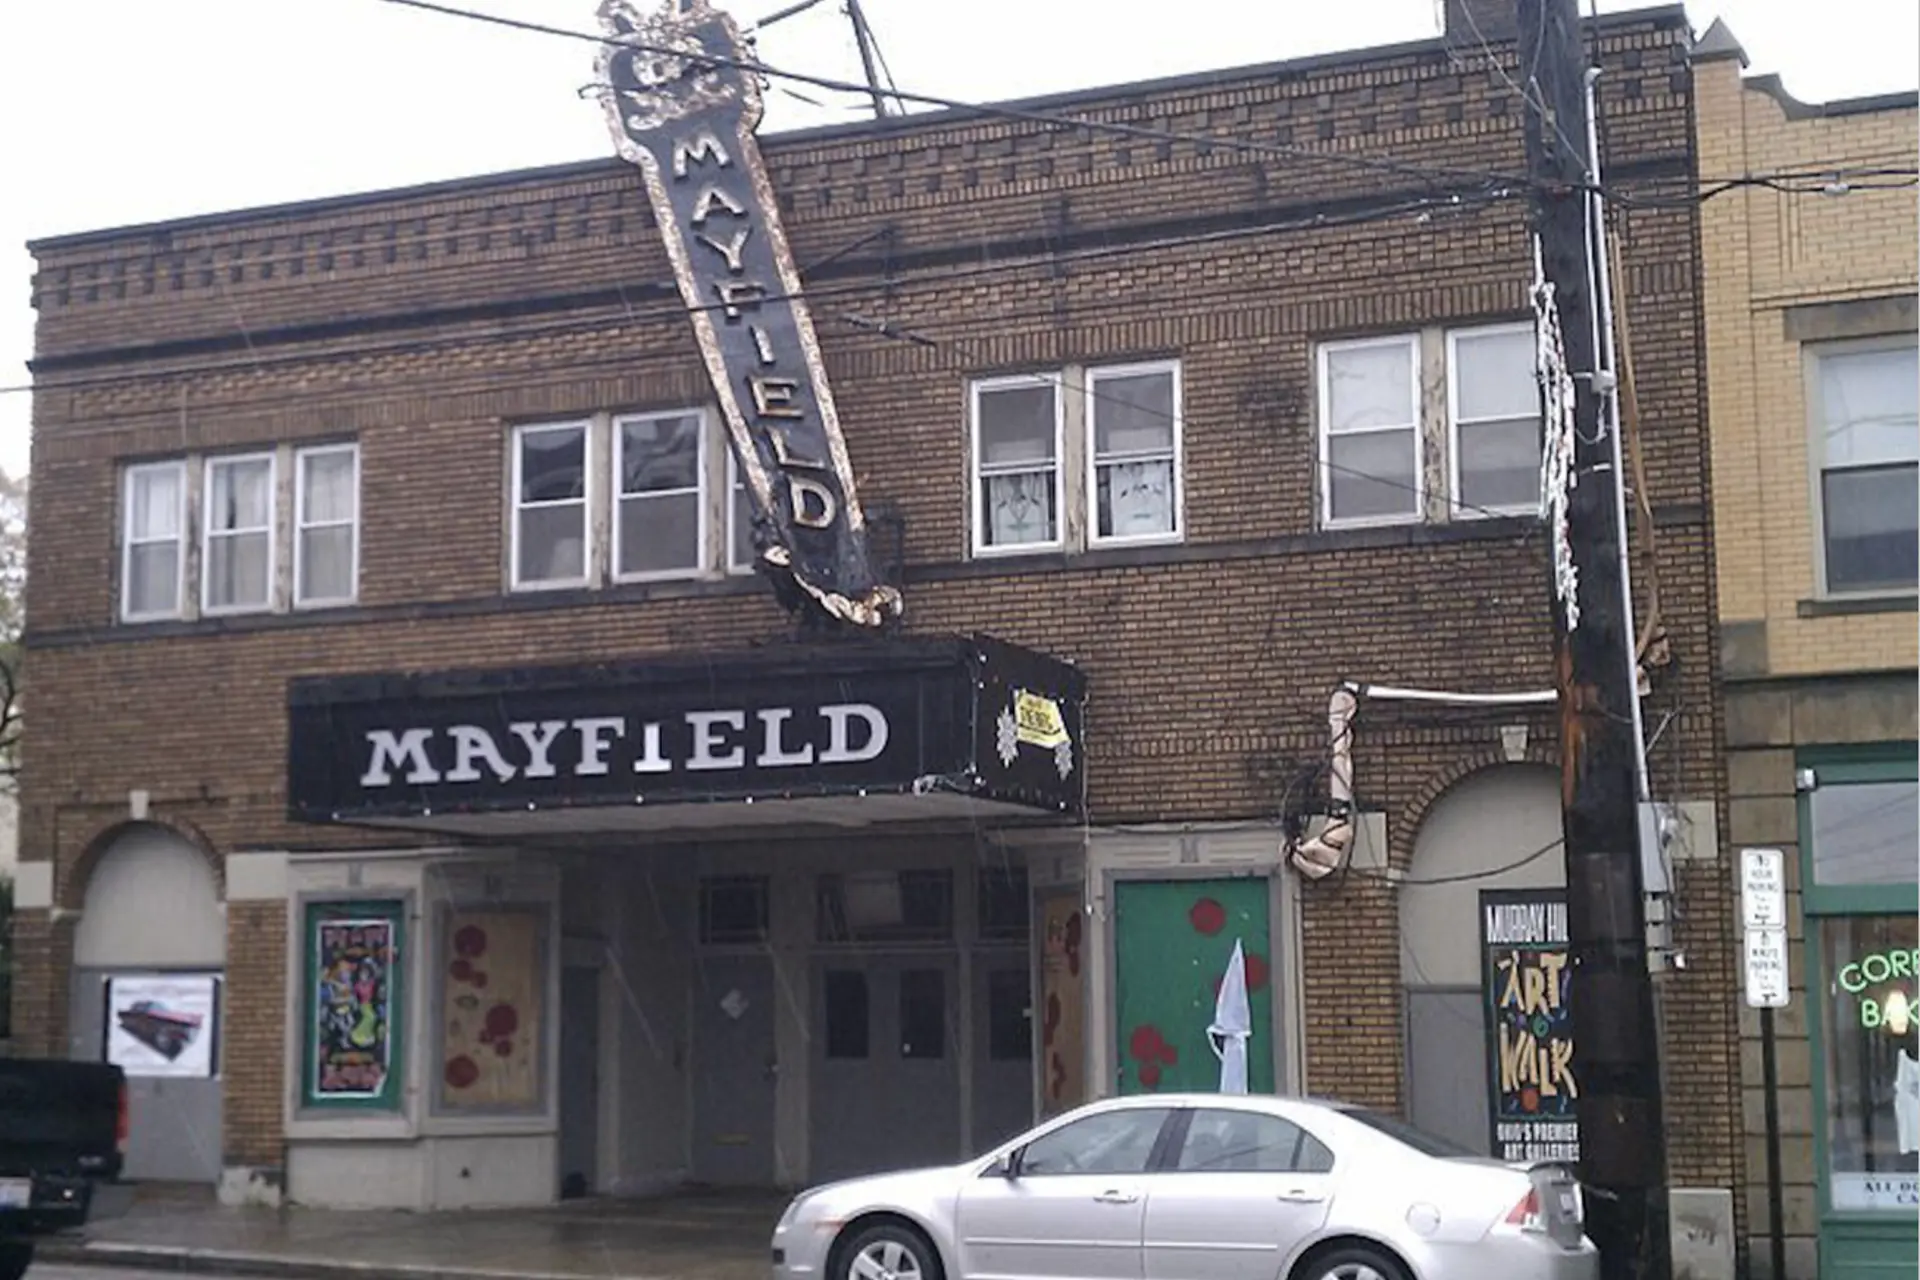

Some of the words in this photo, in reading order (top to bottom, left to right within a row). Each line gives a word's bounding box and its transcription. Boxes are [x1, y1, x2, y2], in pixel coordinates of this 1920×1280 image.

[673, 134, 837, 530] MAYFIELD
[360, 703, 889, 787] MAYFIELD
[1487, 903, 1545, 943] MURRAY
[1498, 950, 1568, 1015] ART
[1501, 1022, 1578, 1099] WALK
[1504, 1143, 1524, 1161] ART
